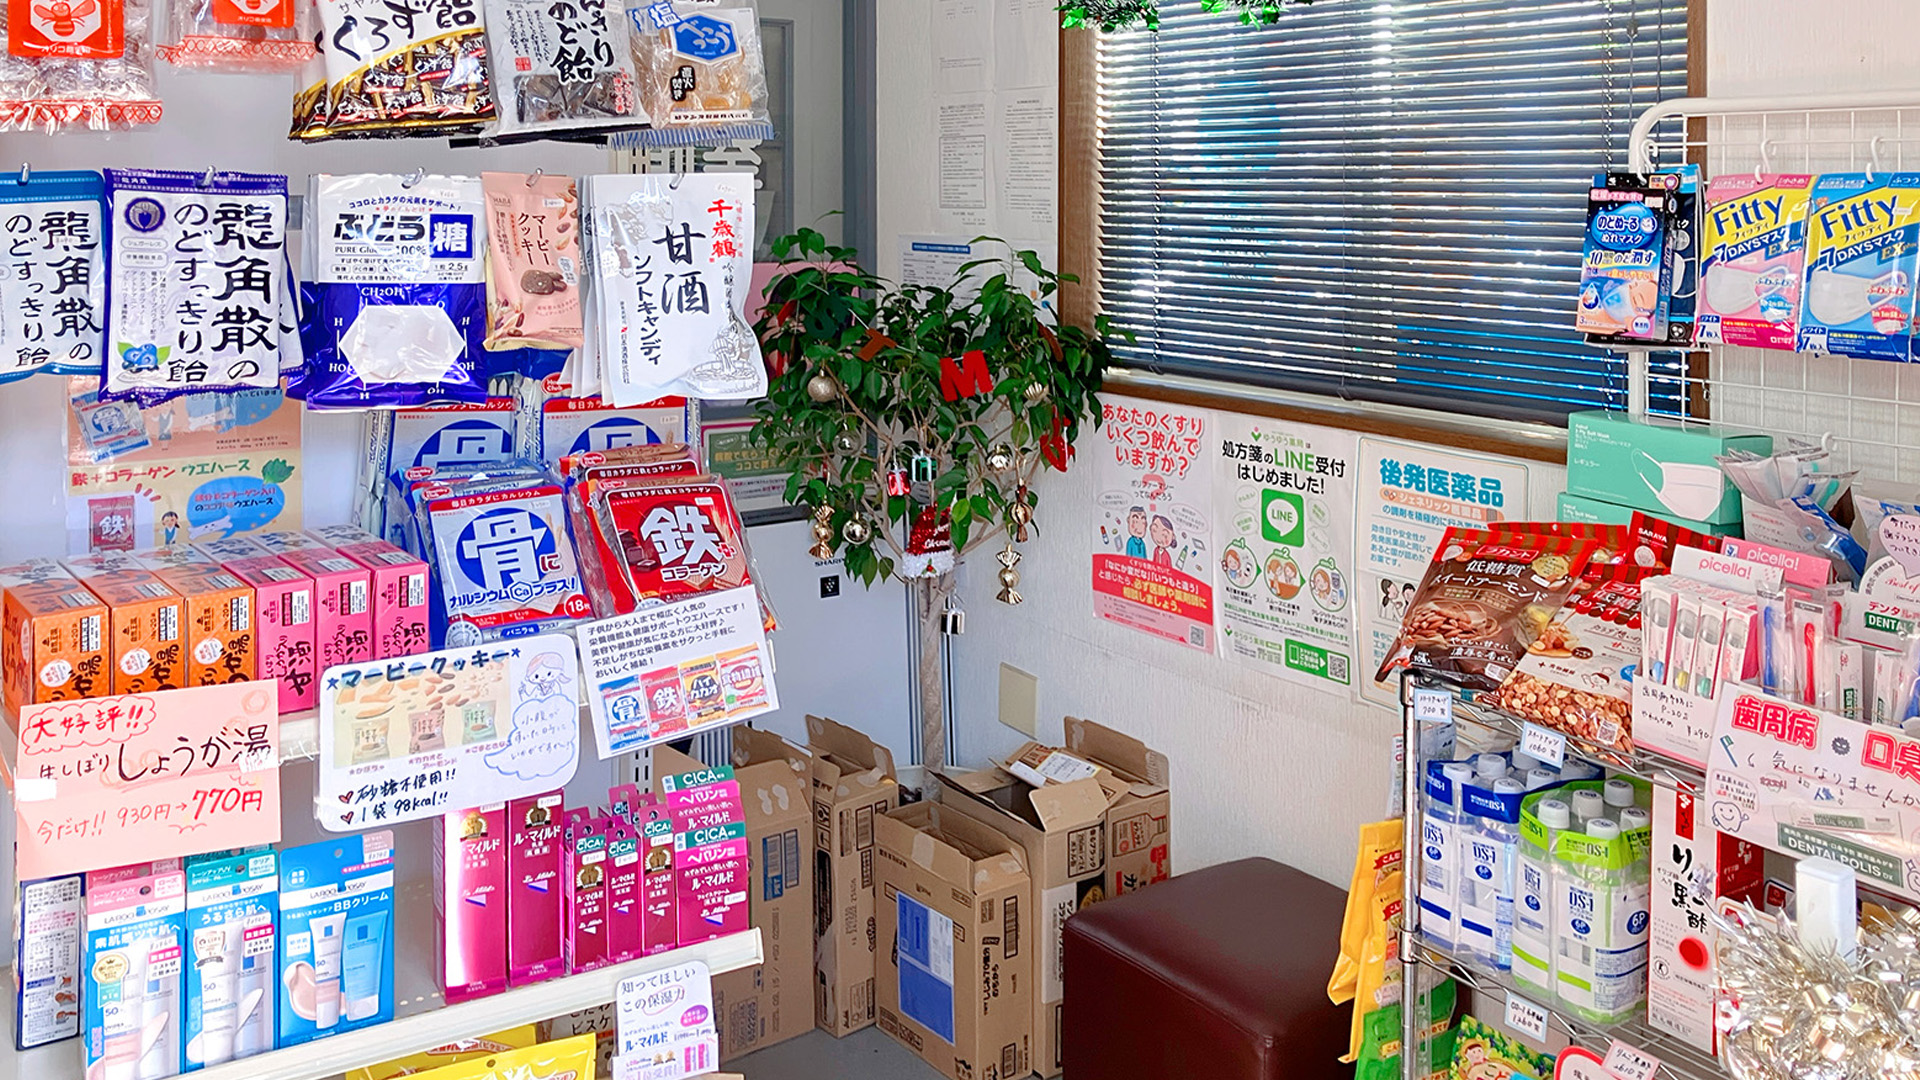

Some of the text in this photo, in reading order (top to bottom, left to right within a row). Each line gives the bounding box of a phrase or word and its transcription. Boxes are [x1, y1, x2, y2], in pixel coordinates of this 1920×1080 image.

[707, 199, 738, 260] 千歳鶴
[1712, 195, 1785, 237] Fitty
[1819, 195, 1899, 240] Fitty
[333, 213, 468, 253] ぶどう 糖
[518, 212, 534, 266] クッキー
[533, 215, 551, 266] マービー
[652, 222, 711, 316] 甘酒
[5, 214, 50, 367] のどすっきり飴
[166, 203, 214, 383] のどすっきり飴
[211, 202, 283, 380] 龍角散の
[939, 349, 993, 402] M
[1102, 403, 1203, 436] あなたのくすり
[1106, 423, 1200, 457] いくつ飲んで
[181, 458, 251, 477] ウエハース
[1115, 445, 1189, 477] いますか?
[1222, 439, 1346, 478] 処方箋のLINE受付
[1237, 463, 1325, 495] はじめました!
[1379, 457, 1504, 508] 後発医薬品
[451, 489, 542, 509] 毎日カラダにカルシウム
[1271, 508, 1293, 523] LINE
[639, 505, 724, 567] 鉄
[1371, 524, 1427, 543] 効き目や安全性が
[1637, 526, 1668, 544] SARAYA
[462, 510, 548, 593] 骨
[541, 554, 562, 574] に
[1370, 554, 1402, 568] お薬です。
[1482, 545, 1533, 560] ラカント
[1746, 546, 1799, 572] picella!
[661, 563, 728, 581] コラーゲン
[1465, 559, 1527, 578] 低糖質
[1698, 555, 1752, 581] picella!
[450, 588, 511, 609] カルシウム
[532, 577, 577, 597] プラス!
[1434, 571, 1548, 604] スイートアーモンド
[587, 601, 707, 636] 子供から大人まで幅広く人気の
[592, 625, 737, 668] 不足しがちな栄養素をサクっと手軽に
[341, 650, 510, 689] マービークッキー
[594, 657, 655, 680] おいしく補給!
[653, 686, 680, 711] 鉄
[31, 704, 144, 744] 大好評!!
[1731, 693, 1820, 751] 歯周病
[39, 753, 110, 780] 生しぼり
[117, 724, 272, 782] しょうが湯
[355, 768, 457, 805] 砂糖不使用!!
[682, 768, 717, 786] CICA
[116, 787, 263, 828] 930円 770円
[360, 791, 449, 823] 1袋 98kcal!!
[679, 788, 720, 805] ヘパリン
[37, 810, 107, 845] 今だけ!!
[644, 823, 668, 835] CICA
[687, 811, 731, 830] ル・マイルド
[694, 825, 728, 843] CICA
[513, 824, 562, 847] ル・マイルド
[576, 838, 601, 851] CICA
[608, 842, 633, 854] CICA
[687, 846, 728, 864] ヘパリン
[1840, 852, 1883, 877] POLIS
[691, 871, 735, 891] ル・マイルド
[333, 892, 389, 913] BBクリーム
[1569, 891, 1594, 912] OS-1
[1631, 911, 1646, 926] 6P
[620, 967, 696, 994] 知ってほしい
[623, 988, 686, 1014] この保湿力
[572, 1014, 611, 1036] ビスケ
[625, 1031, 668, 1053] ル・マイルド
